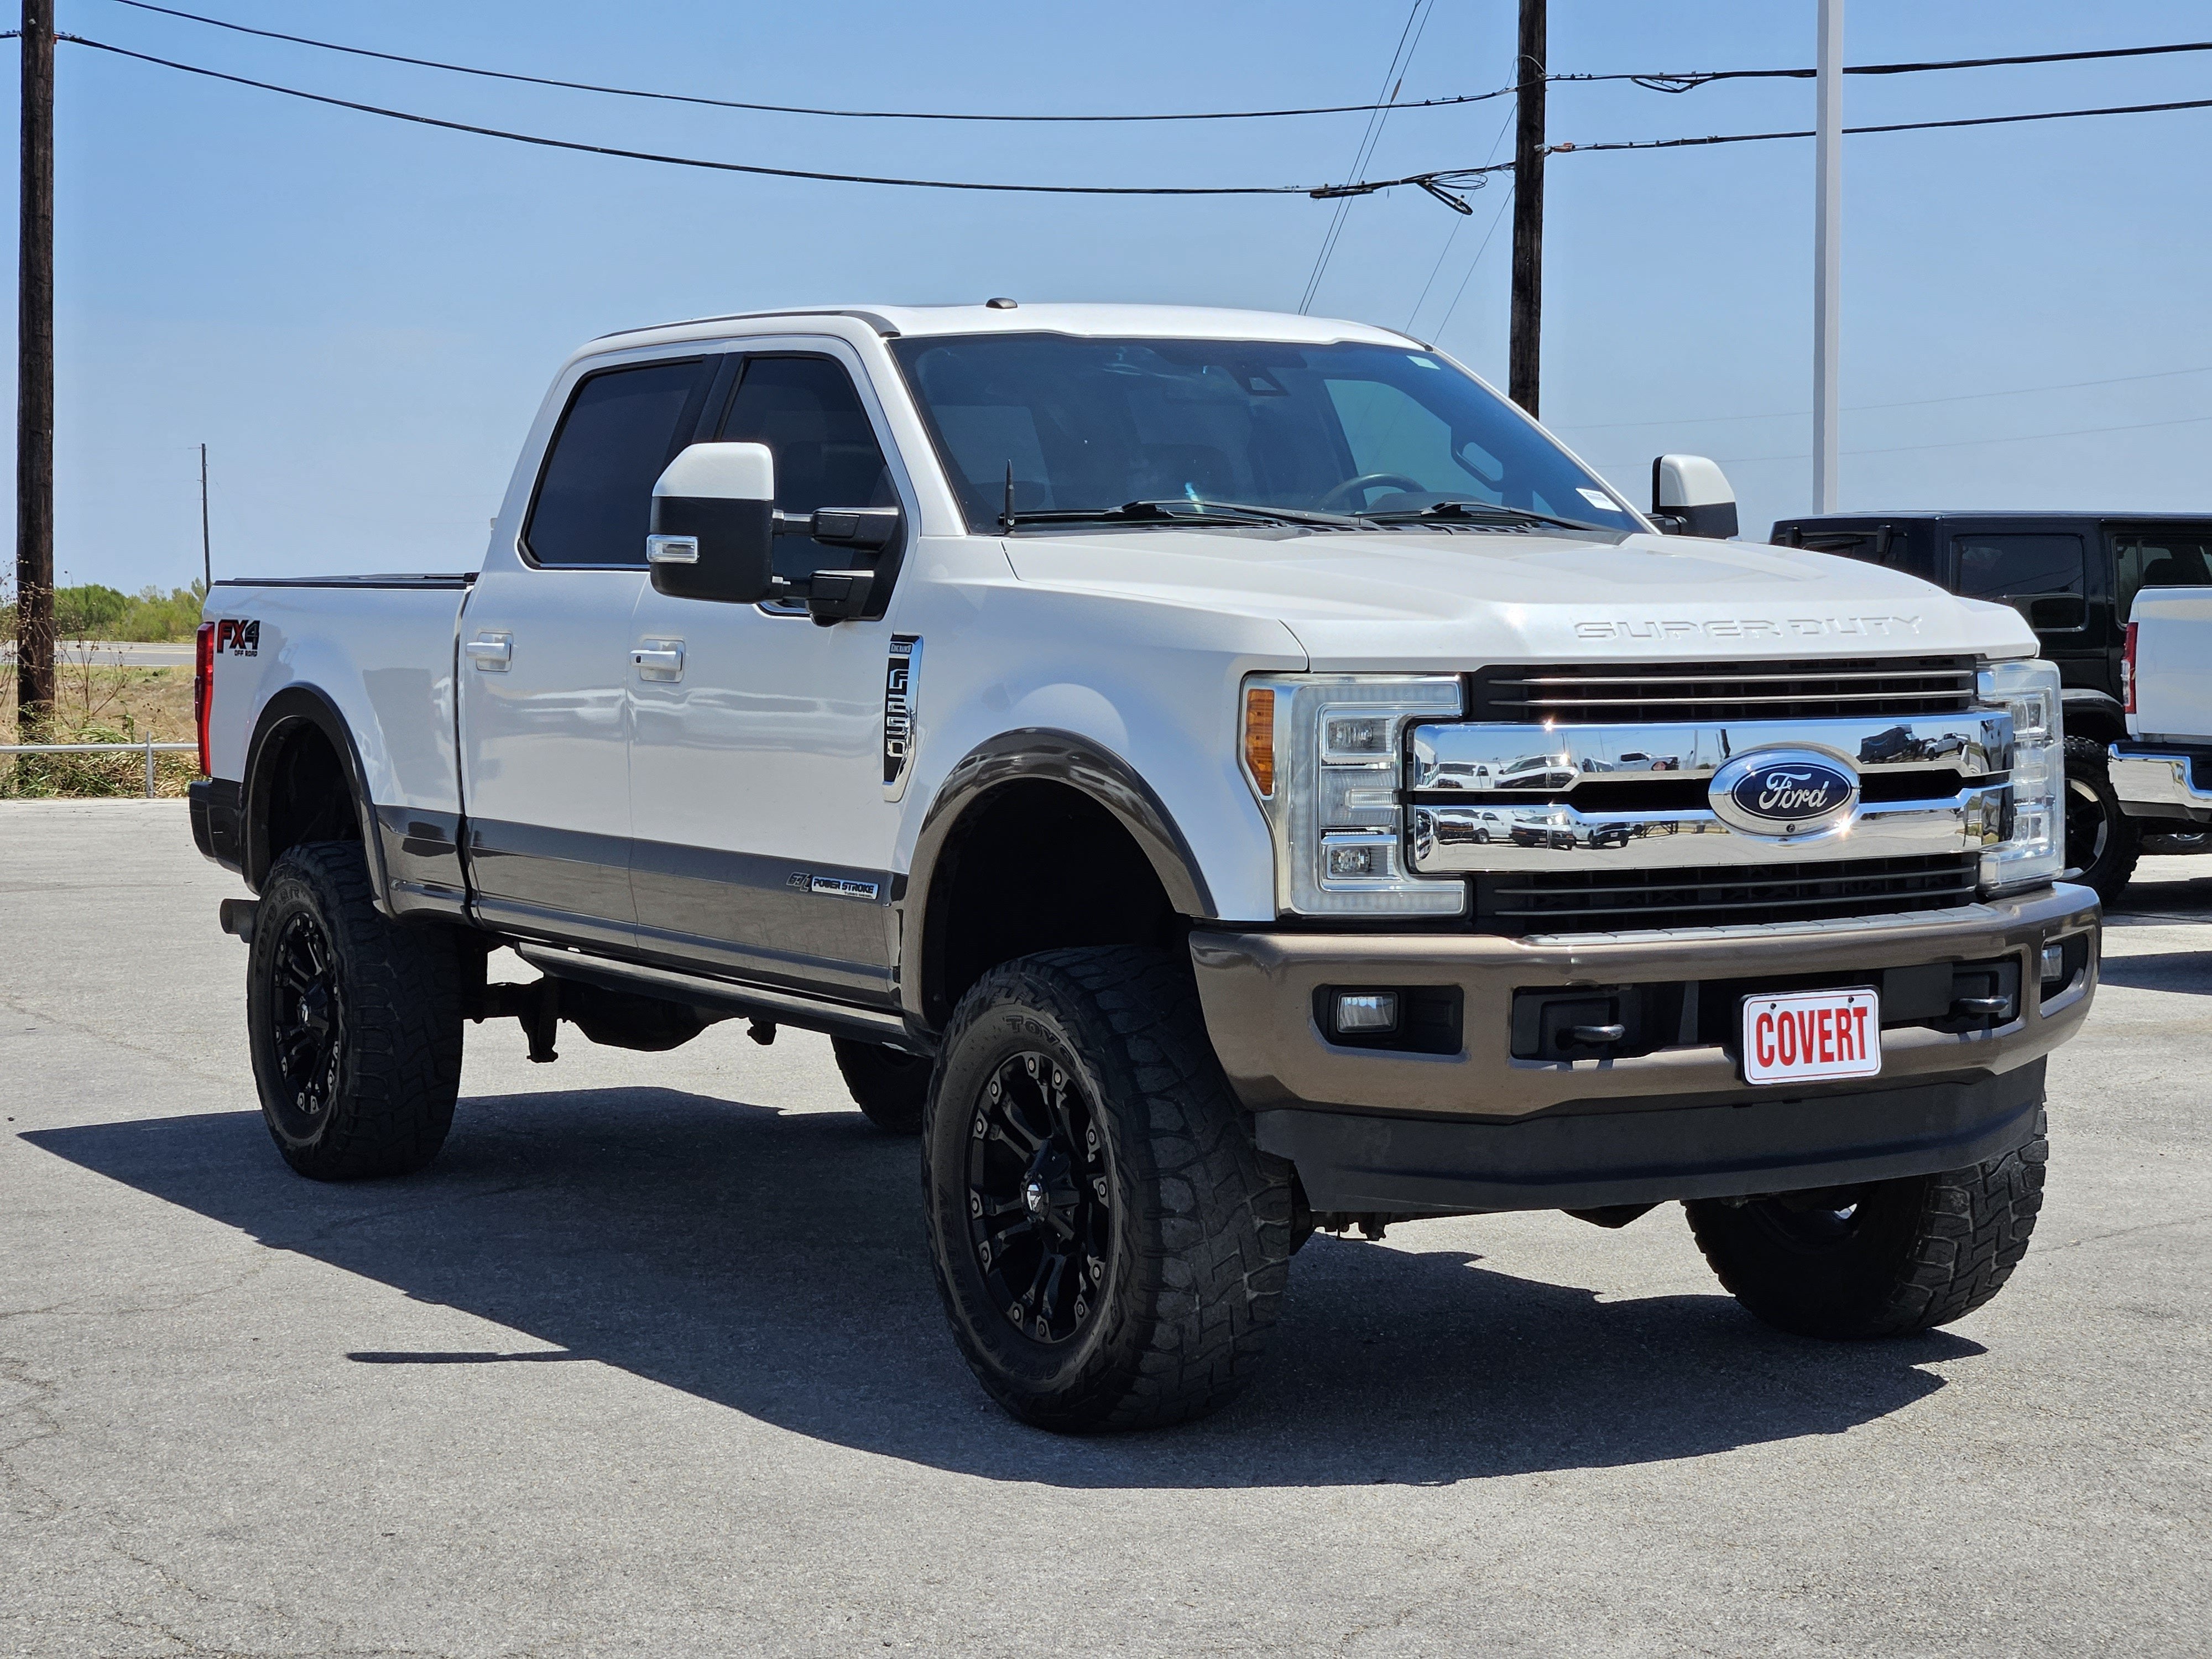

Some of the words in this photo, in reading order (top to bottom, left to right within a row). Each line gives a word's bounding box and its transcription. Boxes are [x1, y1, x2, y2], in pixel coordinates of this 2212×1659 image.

[217, 618, 260, 654] FX4
[1574, 620, 1782, 639] SUPER
[1787, 616, 1922, 635] DUTY
[1759, 772, 1829, 810] Ford
[813, 878, 841, 890] POWER
[842, 881, 874, 894] STROKE
[1006, 1015, 1076, 1070] TOYO
[1756, 1006, 1867, 1067] COVERT
